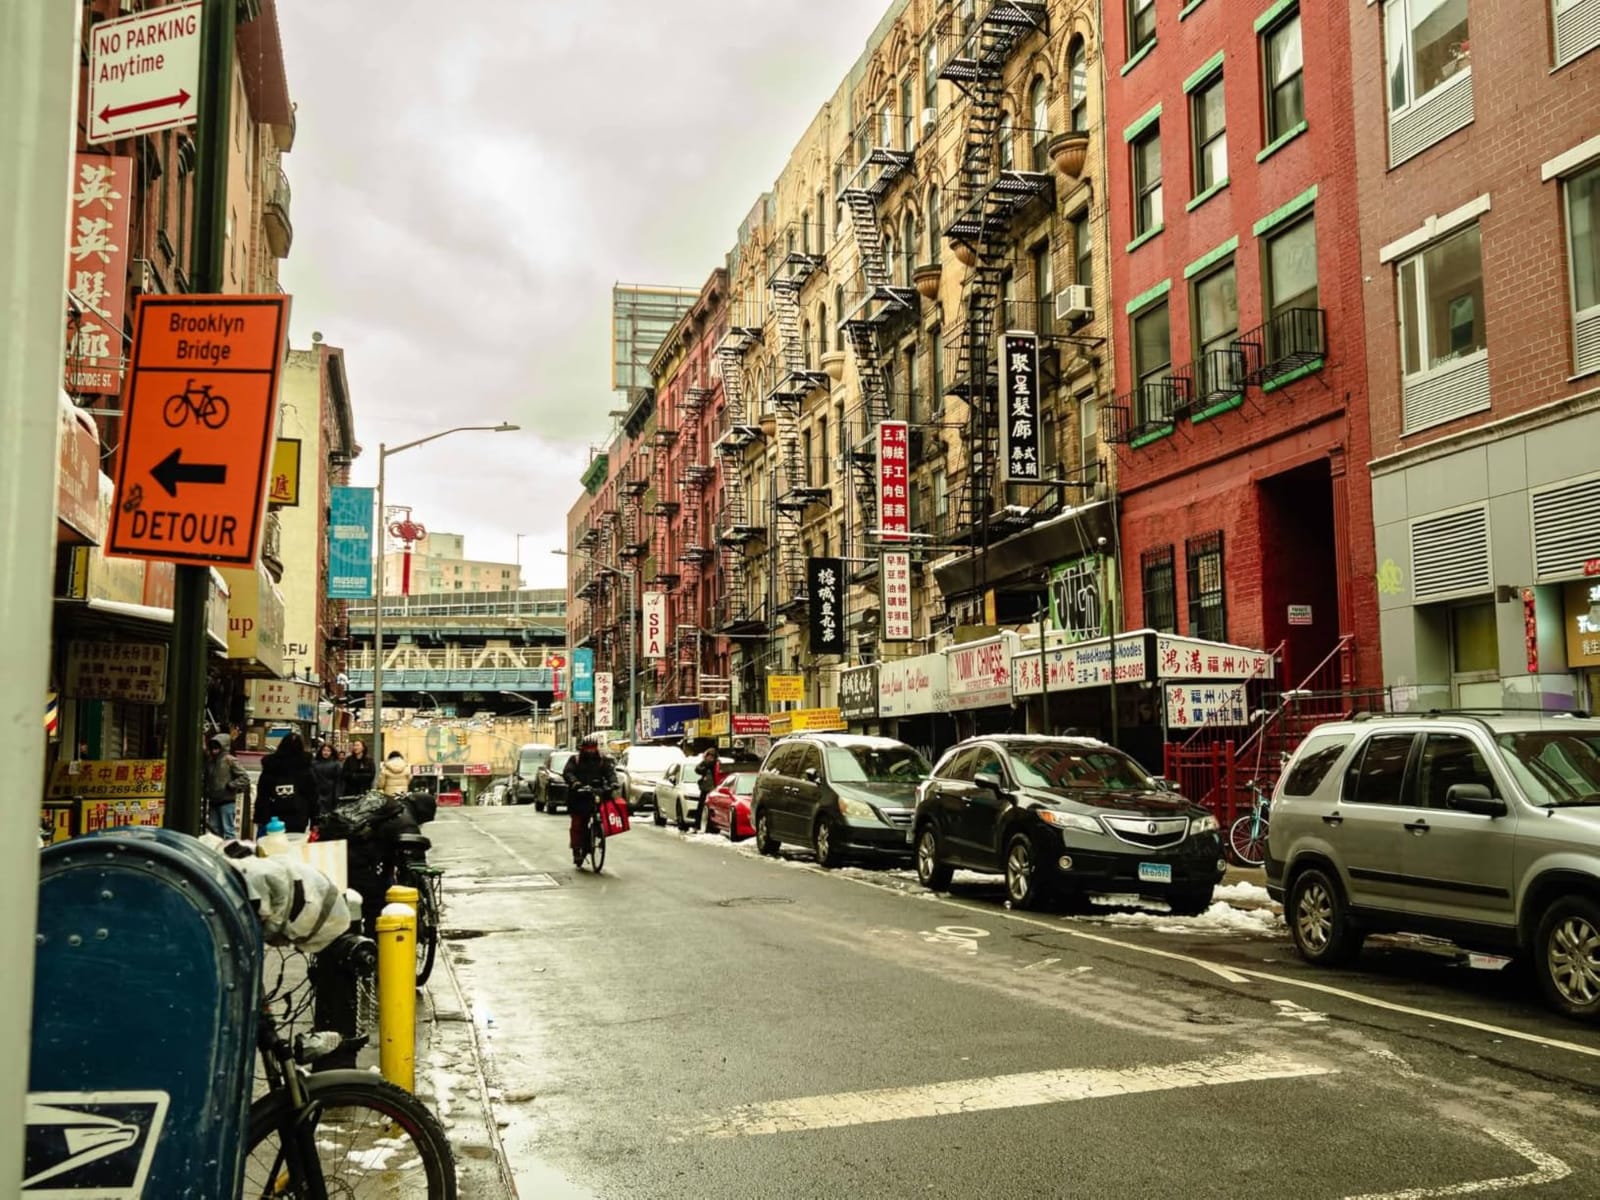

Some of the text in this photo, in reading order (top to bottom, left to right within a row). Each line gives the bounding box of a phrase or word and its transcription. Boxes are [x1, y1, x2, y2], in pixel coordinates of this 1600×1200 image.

[99, 14, 196, 56] NO PARKING
[99, 54, 165, 83] Anytime
[169, 312, 245, 338] Brooklyn
[176, 339, 232, 366] Bridge
[883, 465, 905, 479] 手工
[131, 509, 237, 546] DETOUR
[649, 613, 660, 654] SPA
